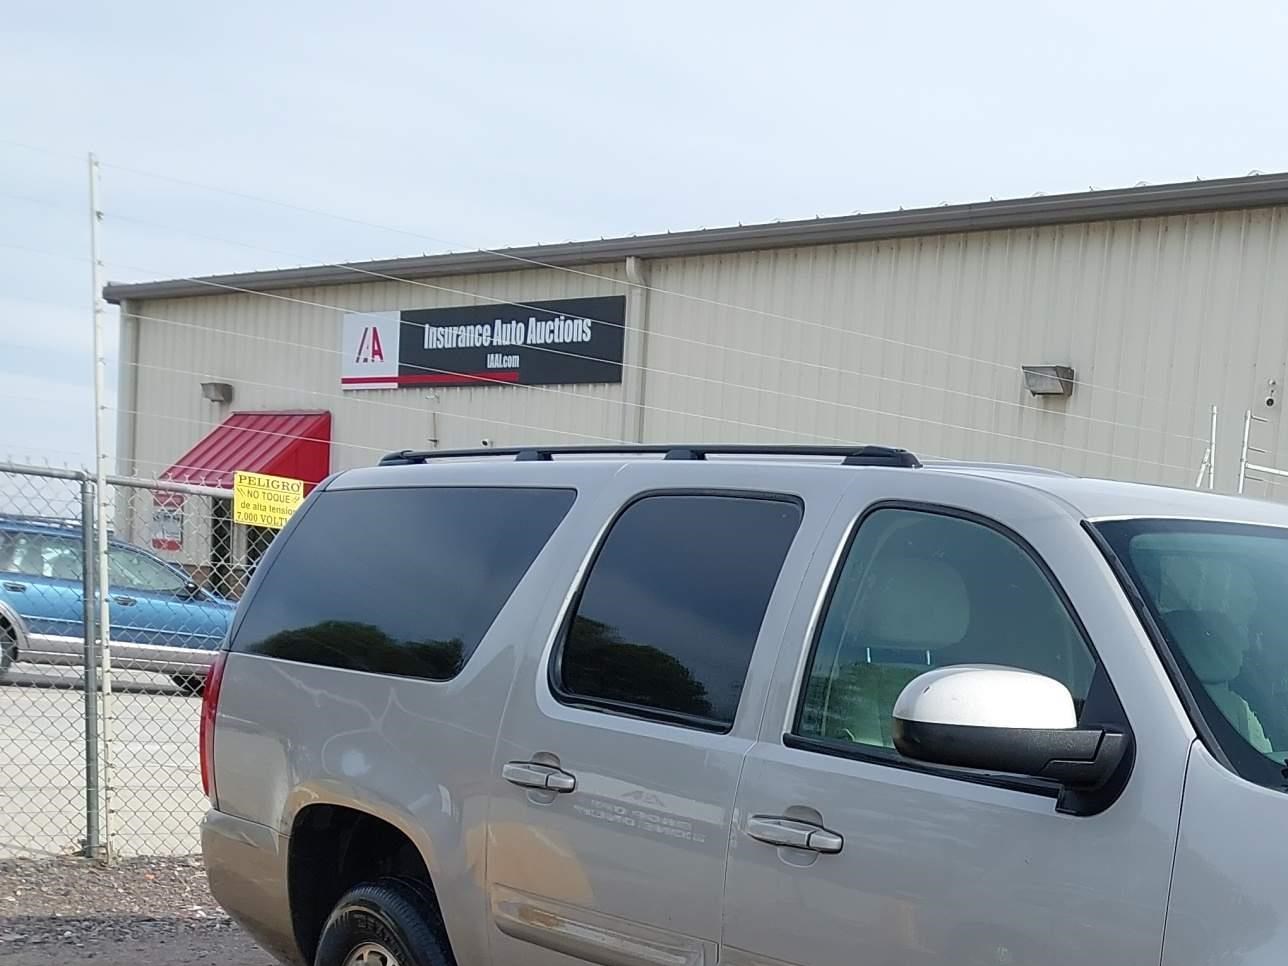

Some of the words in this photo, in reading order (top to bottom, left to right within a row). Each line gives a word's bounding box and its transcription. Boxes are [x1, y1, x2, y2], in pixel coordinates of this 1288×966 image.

[424, 323, 492, 350] Insurance
[493, 319, 525, 346] Auto
[526, 315, 592, 344] Auctions
[487, 353, 520, 369] IAAI.com
[238, 474, 300, 492] PELIGRO
[247, 489, 260, 499] NO
[262, 491, 291, 504] TOQUE
[240, 500, 251, 509] de
[252, 502, 267, 512] alta
[269, 505, 296, 516] tensio
